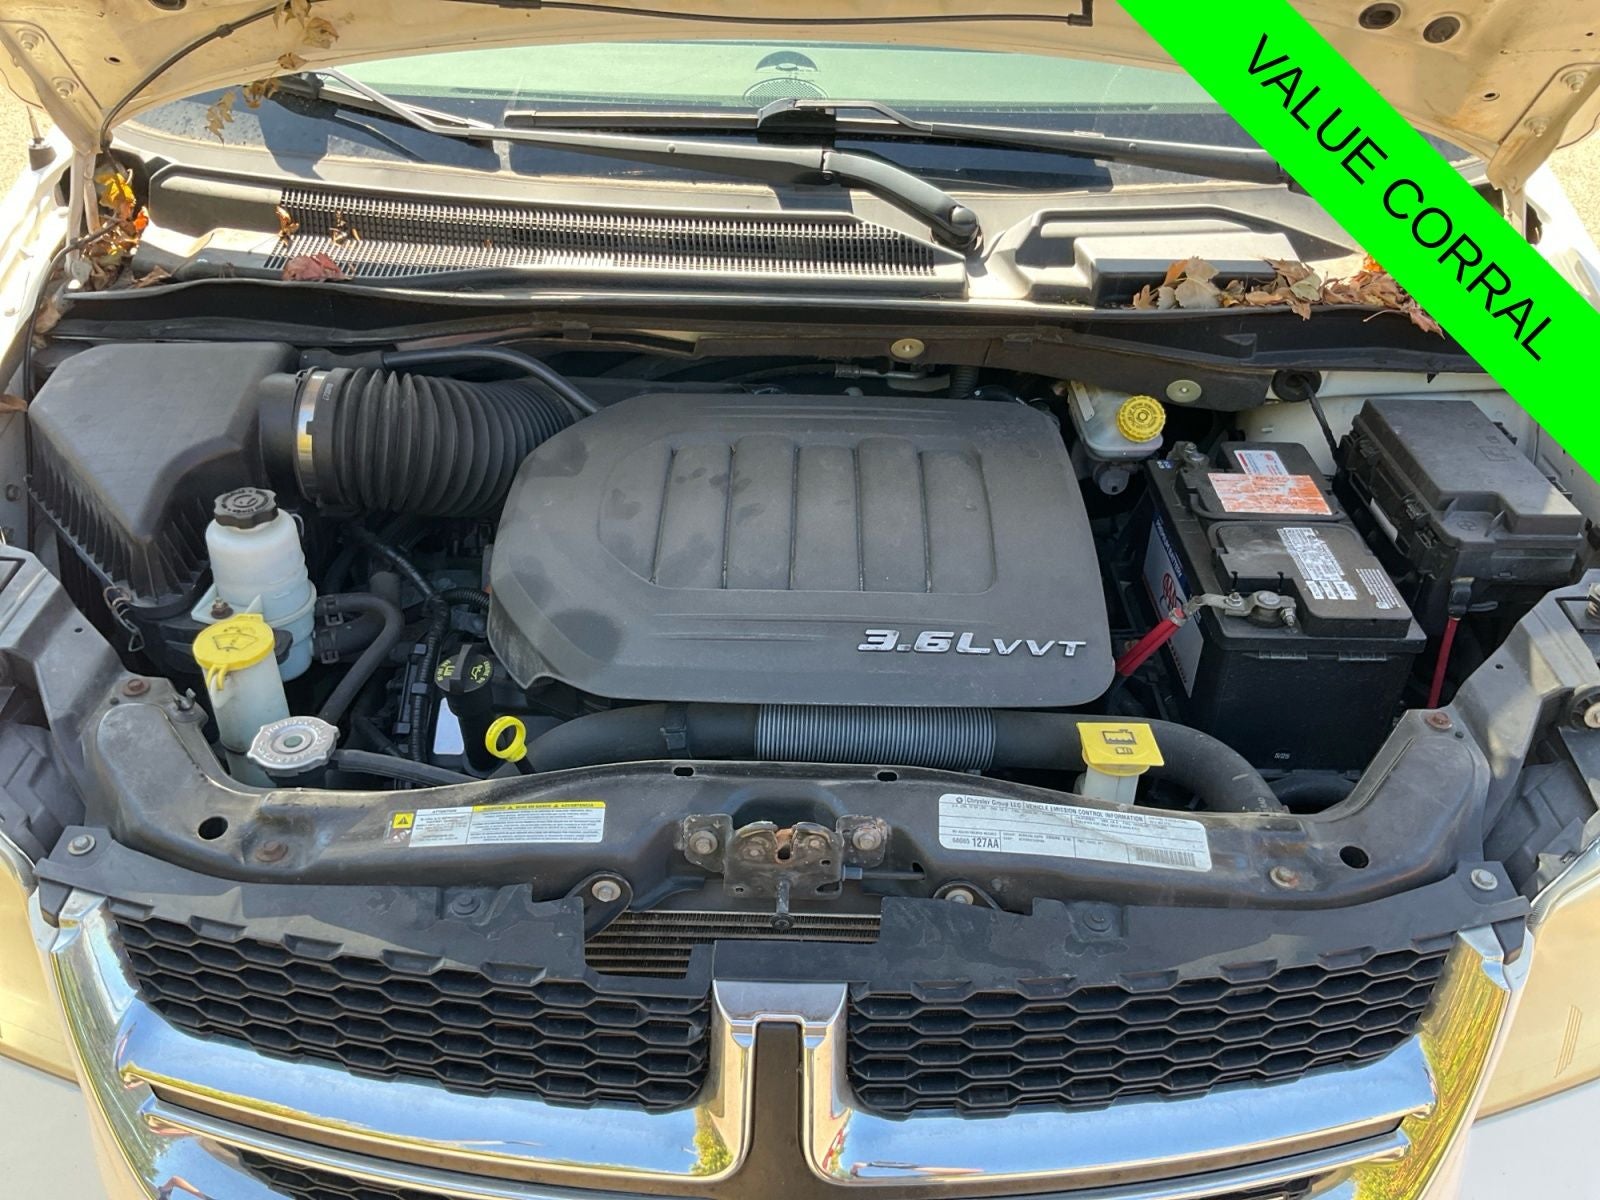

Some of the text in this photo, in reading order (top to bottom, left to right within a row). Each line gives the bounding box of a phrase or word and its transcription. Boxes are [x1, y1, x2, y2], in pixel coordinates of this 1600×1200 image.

[966, 797, 1022, 809] Chrysler Group LLC
[1025, 803, 1050, 812] VEHICLE
[1050, 804, 1077, 814] EMISSION
[1078, 808, 1104, 817] CONTROL
[1104, 810, 1144, 821] INFORMATION
[972, 836, 999, 849] 127AA
